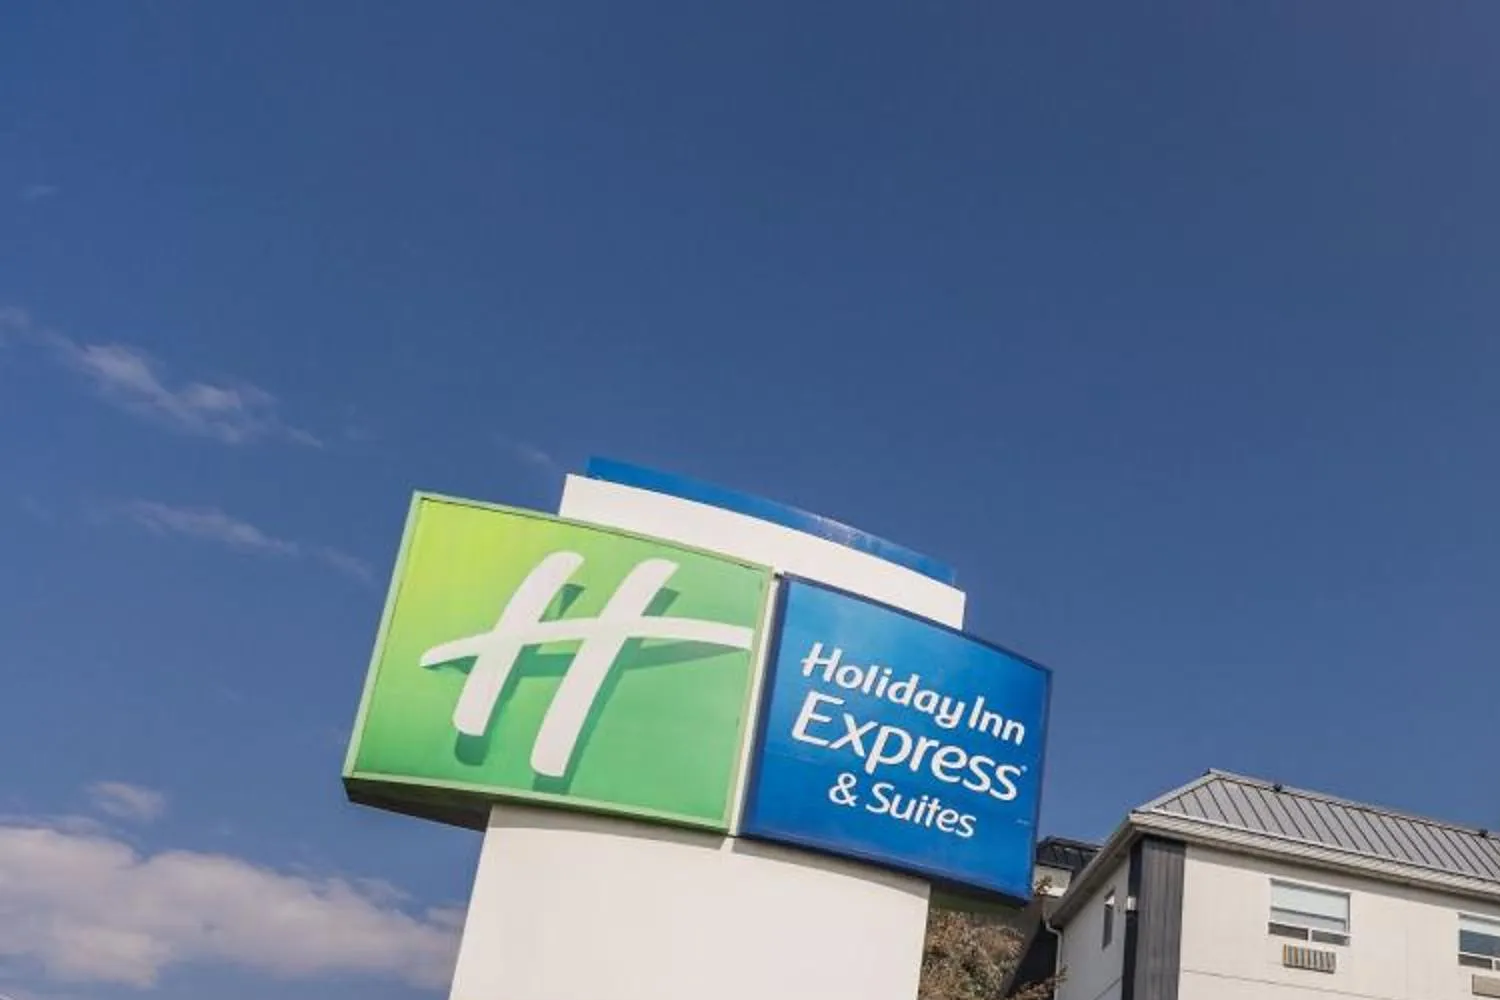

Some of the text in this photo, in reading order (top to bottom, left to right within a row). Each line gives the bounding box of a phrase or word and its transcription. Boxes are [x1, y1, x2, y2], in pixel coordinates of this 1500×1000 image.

[791, 690, 1023, 801] Express
[800, 642, 1026, 746] Holiday Inn
[828, 772, 978, 839] & Suites
